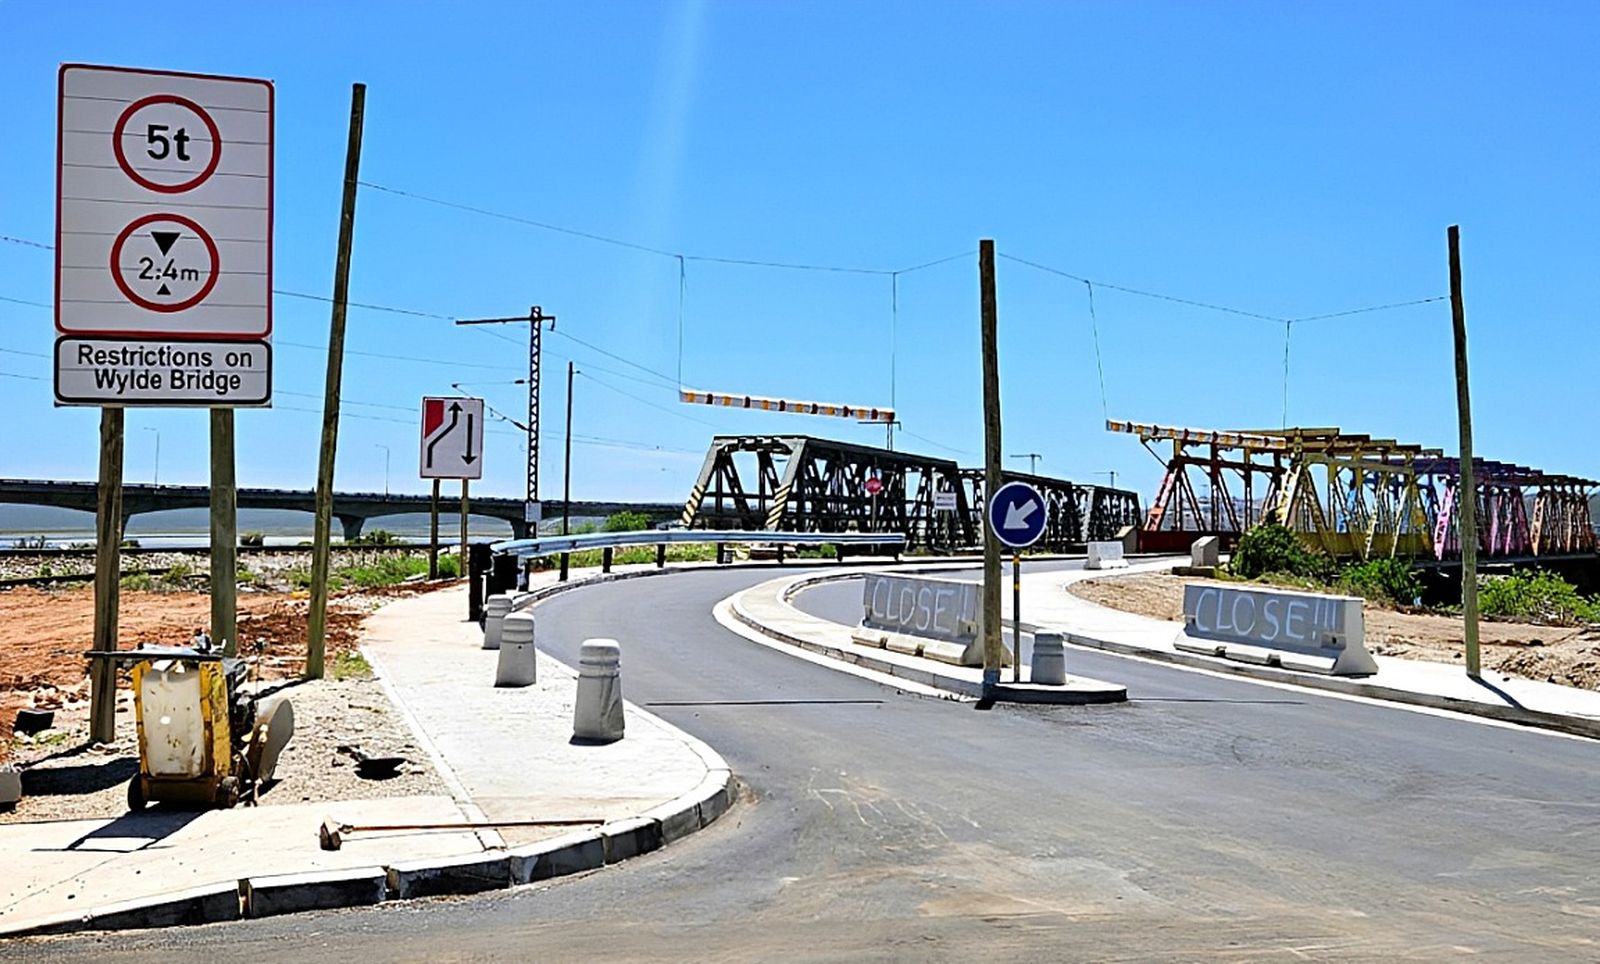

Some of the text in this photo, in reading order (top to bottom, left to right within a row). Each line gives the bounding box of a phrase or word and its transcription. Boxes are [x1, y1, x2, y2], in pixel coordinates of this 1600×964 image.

[147, 124, 191, 162] 5t
[78, 344, 252, 367] Restrictions on
[95, 369, 241, 395] Wylde Bridge
